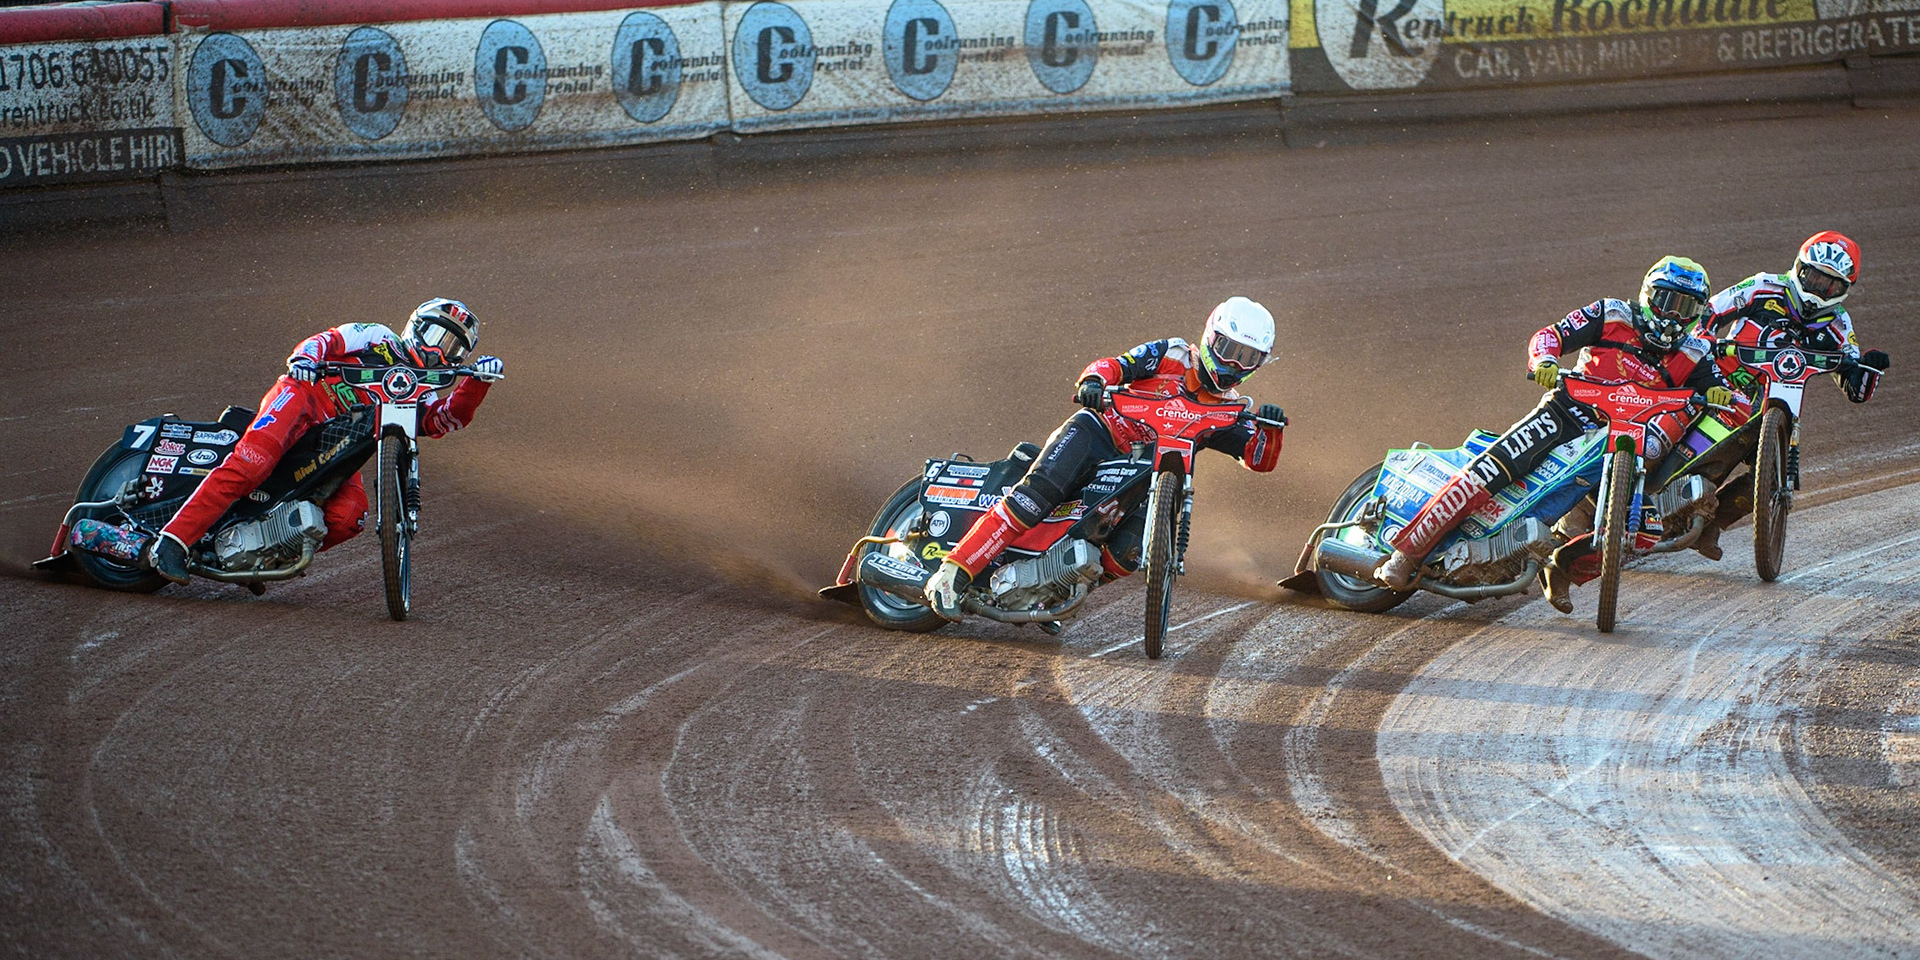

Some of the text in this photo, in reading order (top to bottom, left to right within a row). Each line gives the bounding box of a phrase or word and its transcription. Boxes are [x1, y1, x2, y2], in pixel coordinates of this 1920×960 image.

[1350, 0, 1534, 58] Rentruck
[627, 38, 726, 95] Coolrunnin
[16, 137, 125, 177] VEHICLE
[1608, 393, 1653, 406] Crendon
[1155, 407, 1202, 420] Crendon
[131, 424, 156, 448] 7
[150, 456, 174, 467] NGK
[926, 462, 942, 478] 6
[1381, 474, 1426, 503] MERIDIAN
[1409, 411, 1559, 550] MERIDIAN LIFTS
